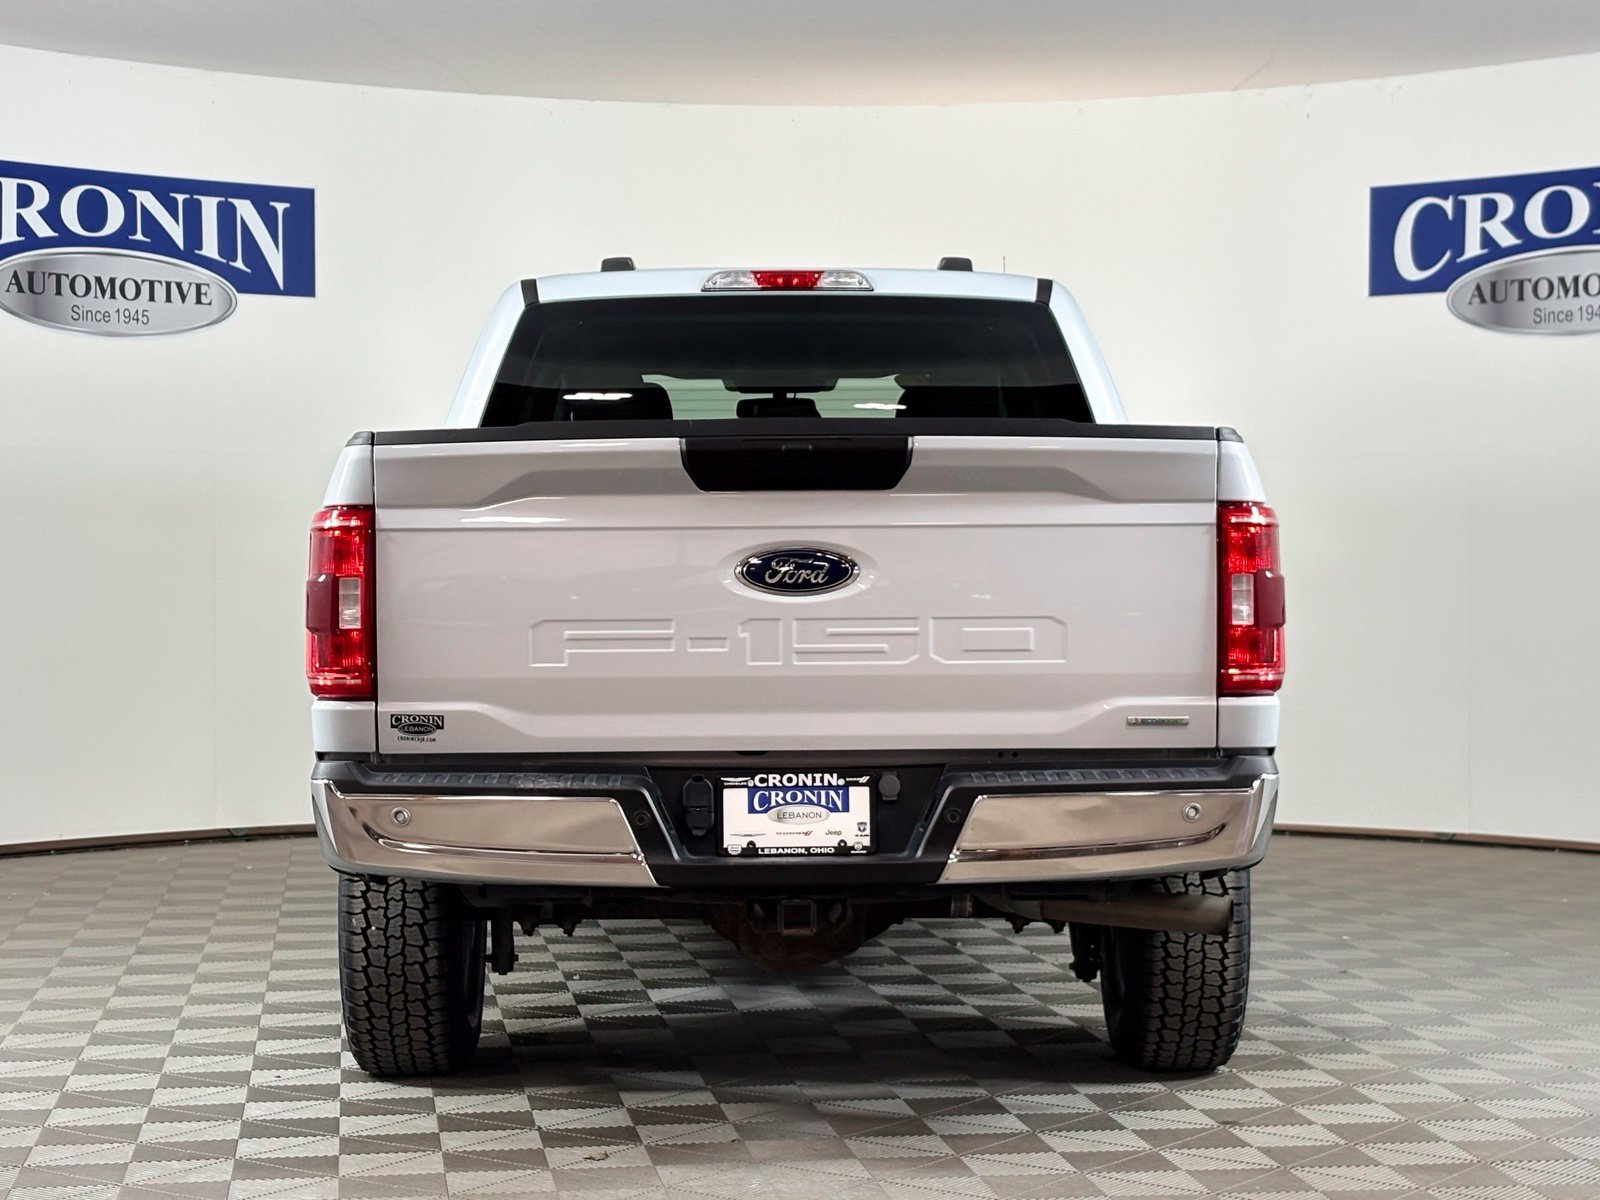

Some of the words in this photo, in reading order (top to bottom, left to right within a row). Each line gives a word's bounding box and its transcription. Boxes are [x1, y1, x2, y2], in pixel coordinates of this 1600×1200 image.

[1393, 182, 1600, 282] CRO
[5, 270, 213, 306] AUTOMOTIVE
[71, 304, 111, 323] Since
[115, 308, 150, 325] 1945
[1533, 306, 1574, 325] Since
[764, 557, 831, 584] Ford
[528, 616, 1067, 667] F-150
[391, 714, 443, 727] CRONIN
[753, 773, 838, 787] CRONIN
[753, 790, 844, 811] CRONIN
[776, 811, 822, 820] LEBANON
[758, 847, 808, 855] LEBANON,
